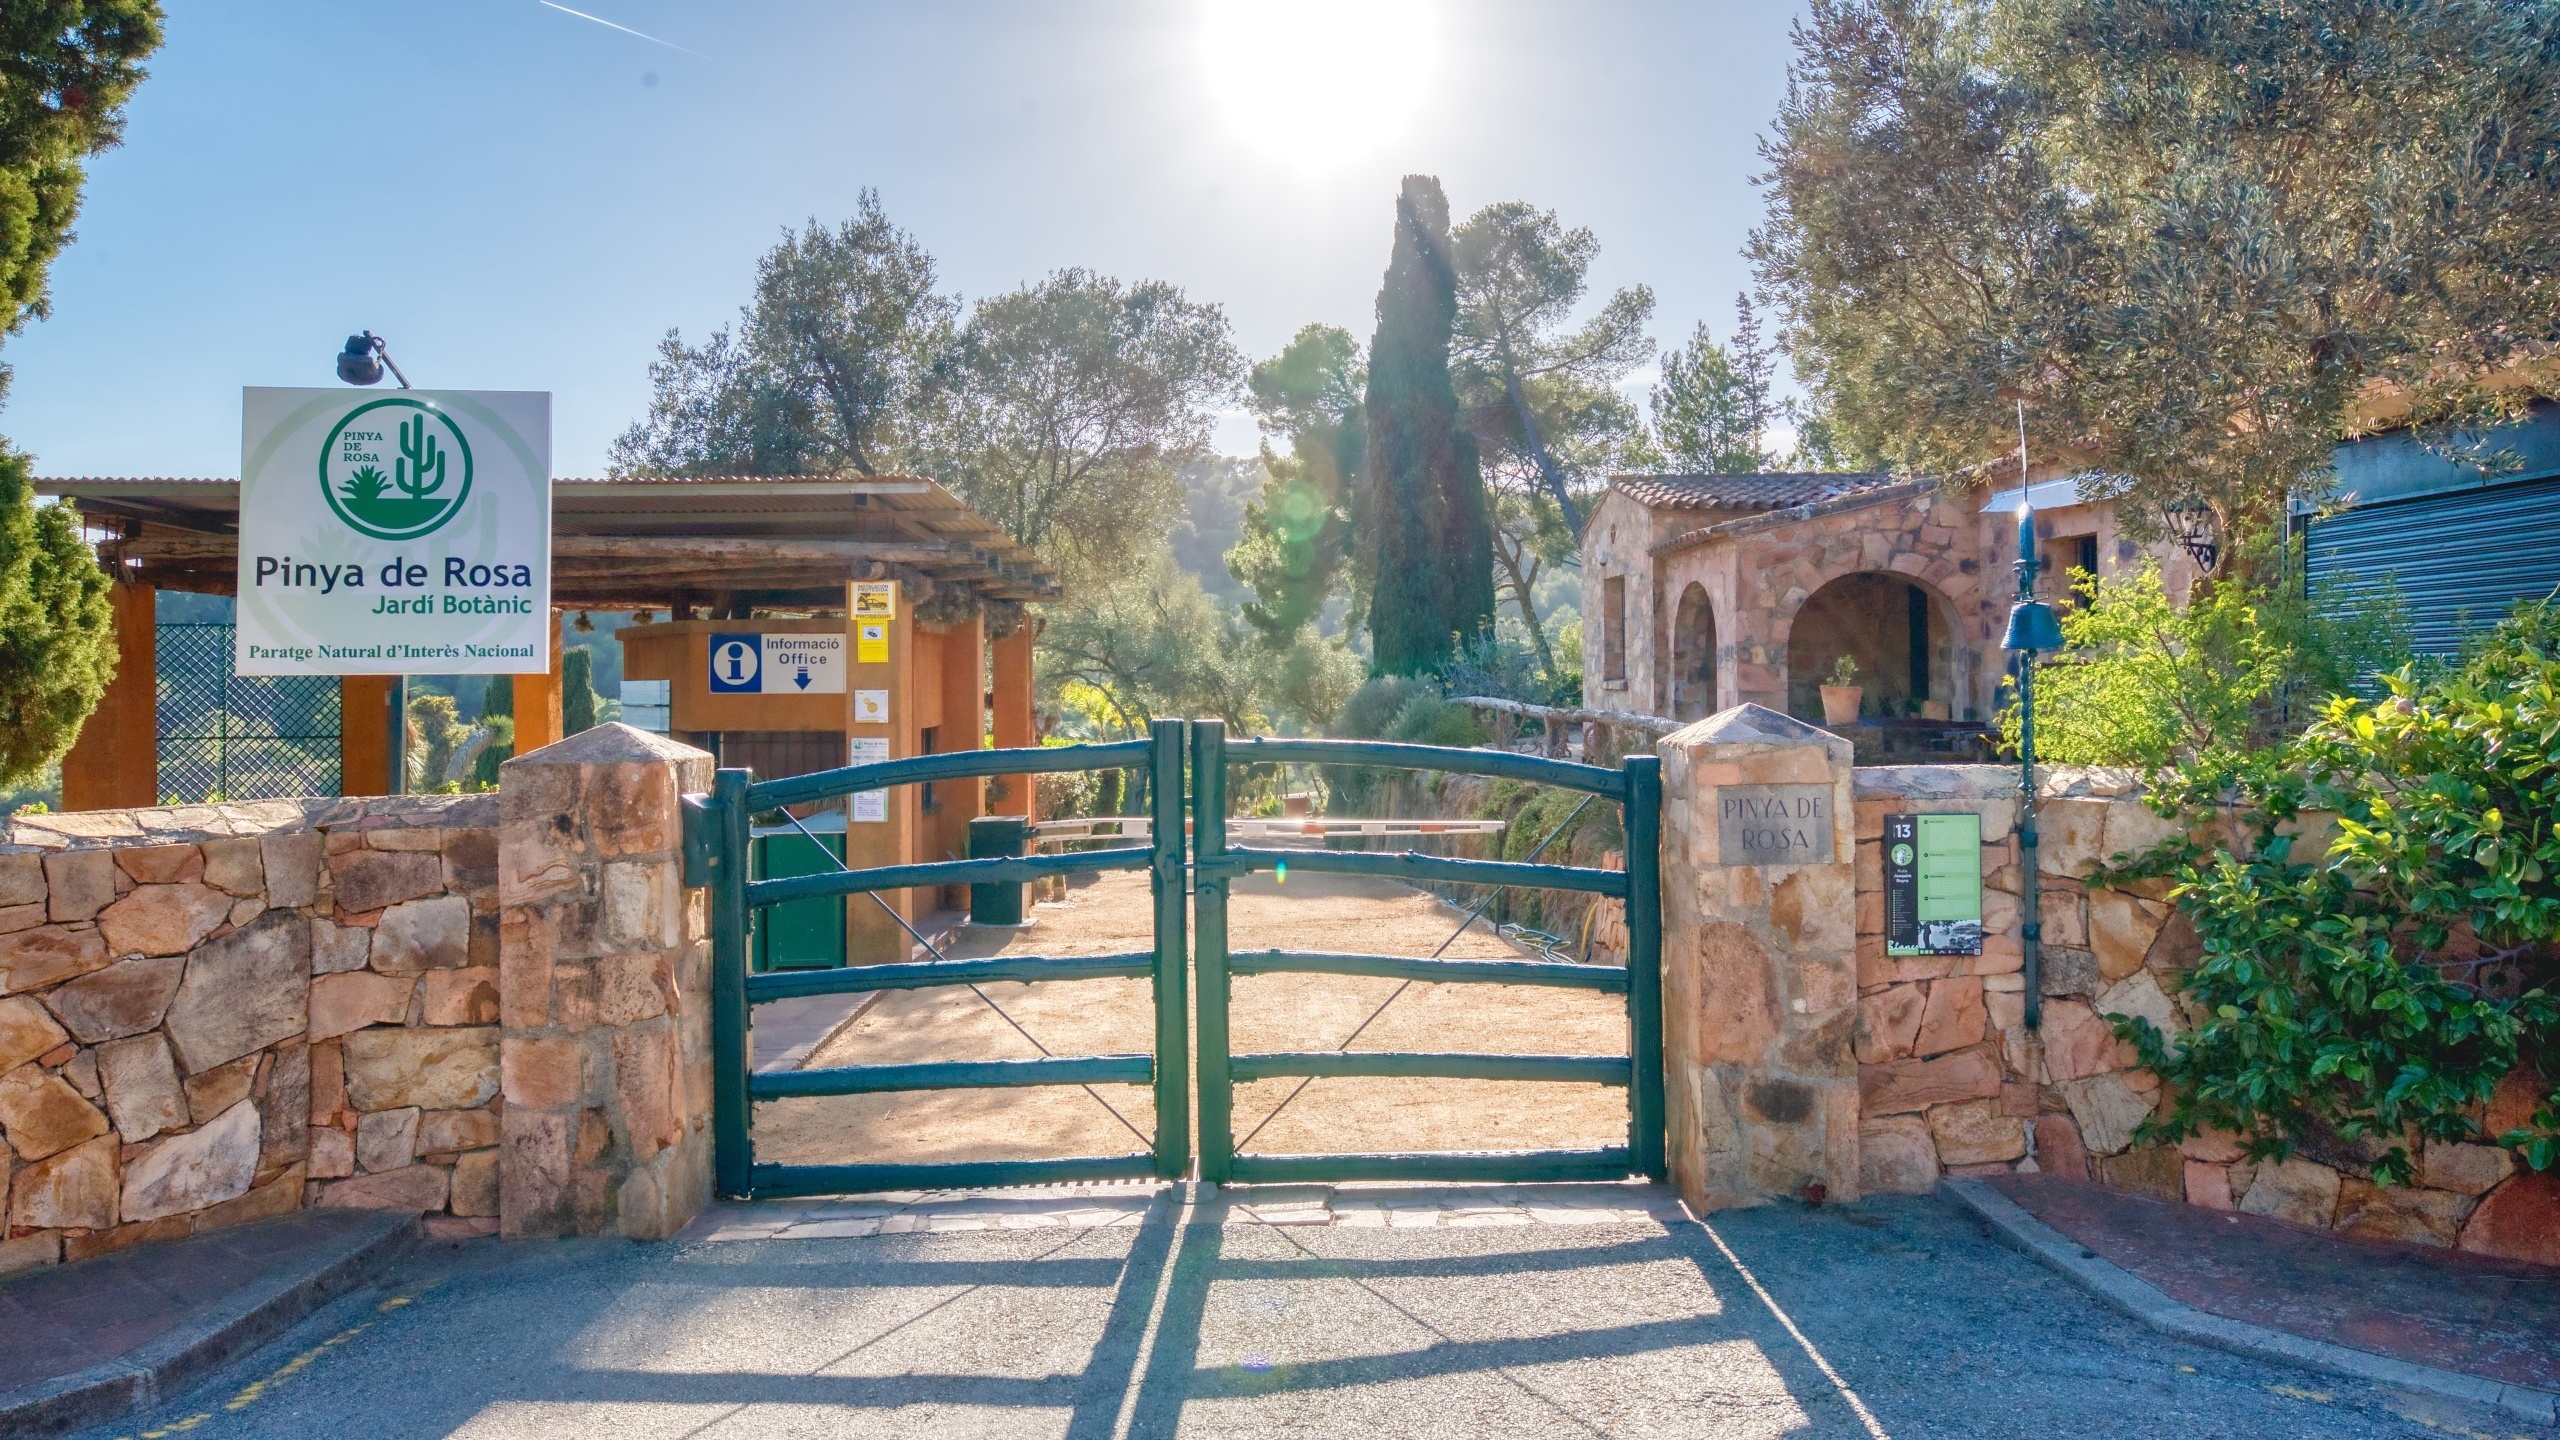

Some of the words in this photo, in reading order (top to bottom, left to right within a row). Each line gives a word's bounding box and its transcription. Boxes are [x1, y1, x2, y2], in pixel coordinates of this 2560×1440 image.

[343, 431, 383, 441] PINYA
[343, 442, 362, 451] DE
[343, 452, 380, 462] ROSA
[256, 556, 364, 594] Pinya
[380, 556, 428, 586] de
[444, 556, 532, 587] Rosa
[372, 594, 434, 614] Jardí
[444, 595, 532, 614] Botànic
[766, 638, 840, 650] Informació
[249, 646, 313, 662] Paratge
[318, 644, 382, 658] Natural
[386, 644, 459, 658] d’Interès
[464, 644, 534, 658] Nacional
[778, 653, 828, 665] Office
[1724, 798, 1789, 818] PINYA
[1798, 798, 1824, 818] DE
[1895, 824, 1911, 838] 13
[1742, 828, 1809, 850] ROSA
